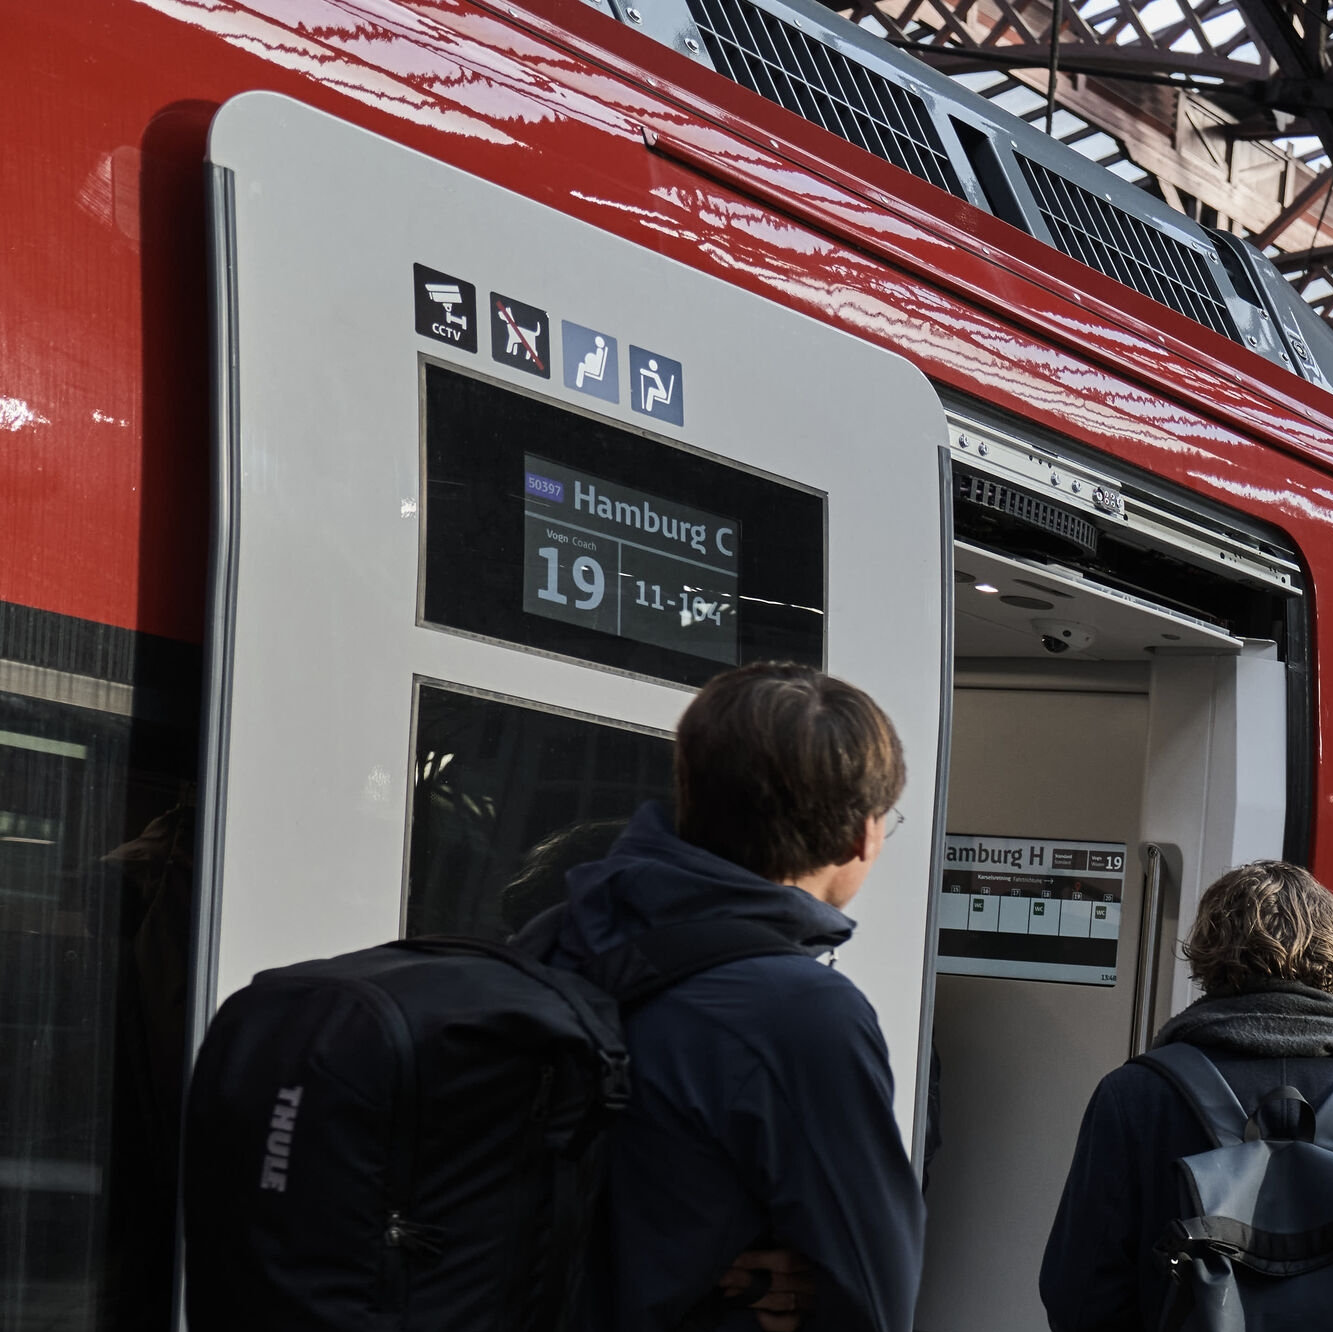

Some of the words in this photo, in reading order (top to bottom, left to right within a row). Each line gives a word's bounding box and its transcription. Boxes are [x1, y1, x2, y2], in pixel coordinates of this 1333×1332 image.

[431, 322, 461, 341] CCTV
[528, 477, 561, 497] 50397
[574, 480, 707, 555] Hamburg
[715, 527, 733, 557] C
[546, 528, 569, 544] Vogn
[572, 536, 597, 551] Coach
[537, 546, 605, 610] 19
[635, 580, 721, 627] 11-104
[945, 842, 1023, 869] amburg
[1029, 846, 1045, 866] H
[1105, 855, 1122, 870] 19
[260, 1085, 304, 1192] THULE
